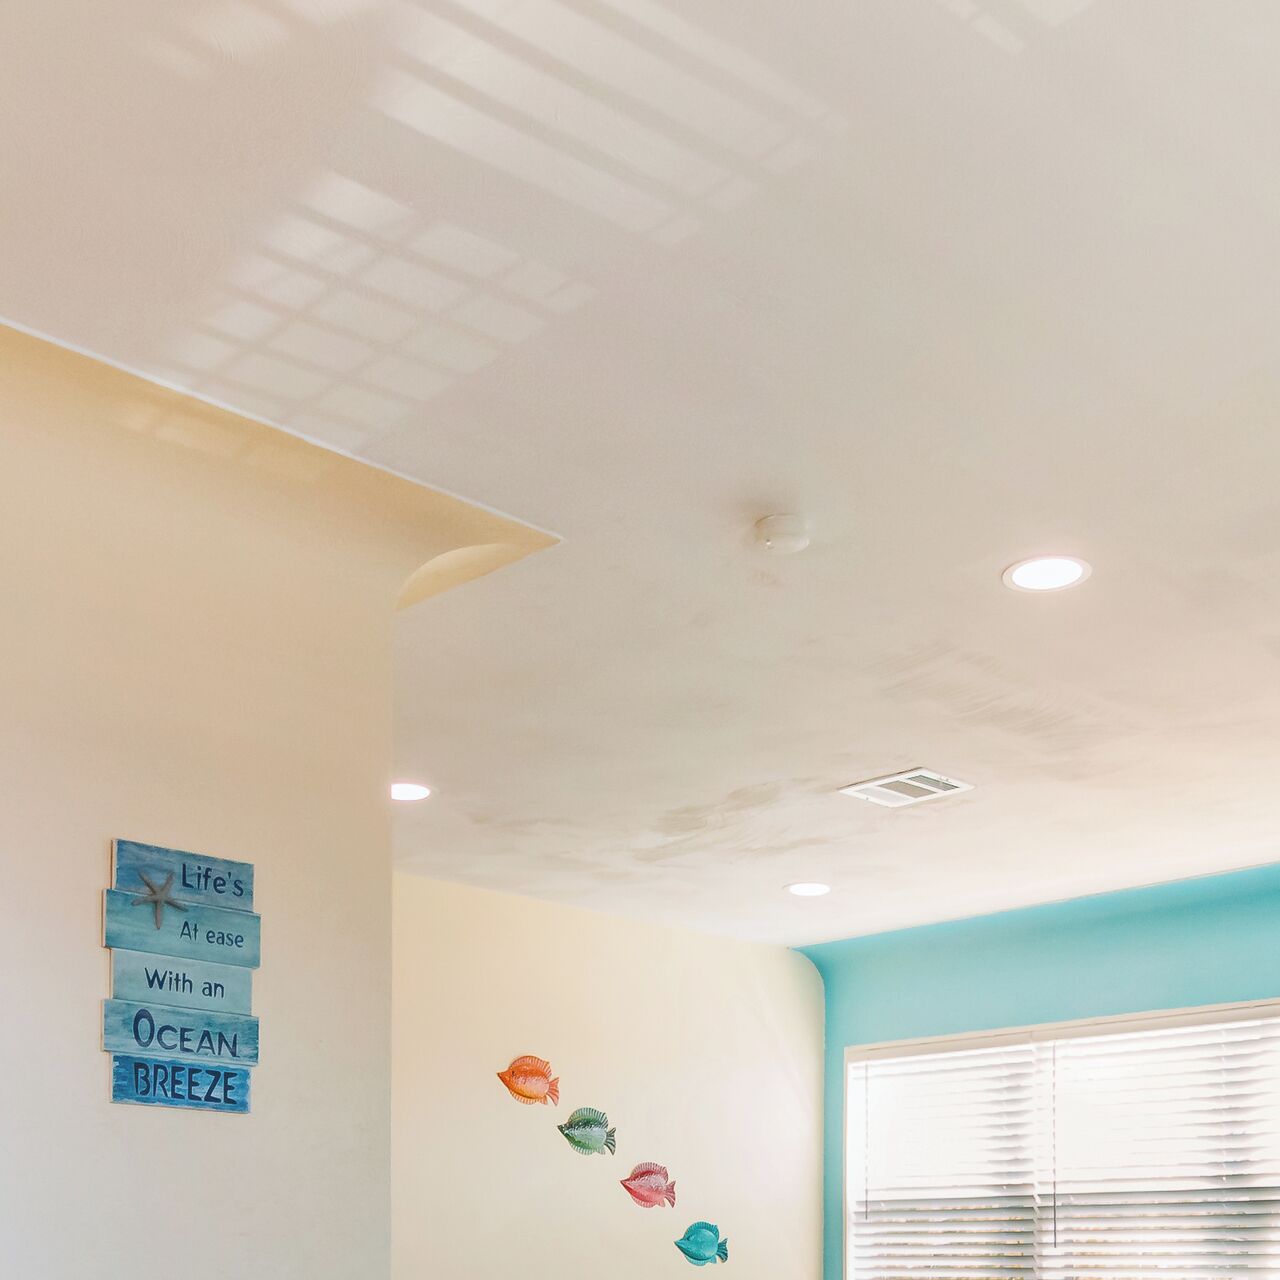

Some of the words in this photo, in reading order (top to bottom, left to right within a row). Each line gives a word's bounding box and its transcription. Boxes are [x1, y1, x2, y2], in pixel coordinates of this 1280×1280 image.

[180, 863, 245, 897] Life's
[180, 920, 199, 942] At
[206, 929, 245, 949] ease
[144, 966, 194, 995] With
[201, 979, 225, 999] an
[132, 1007, 240, 1058] OCEAN
[133, 1061, 239, 1105] BREEZE
